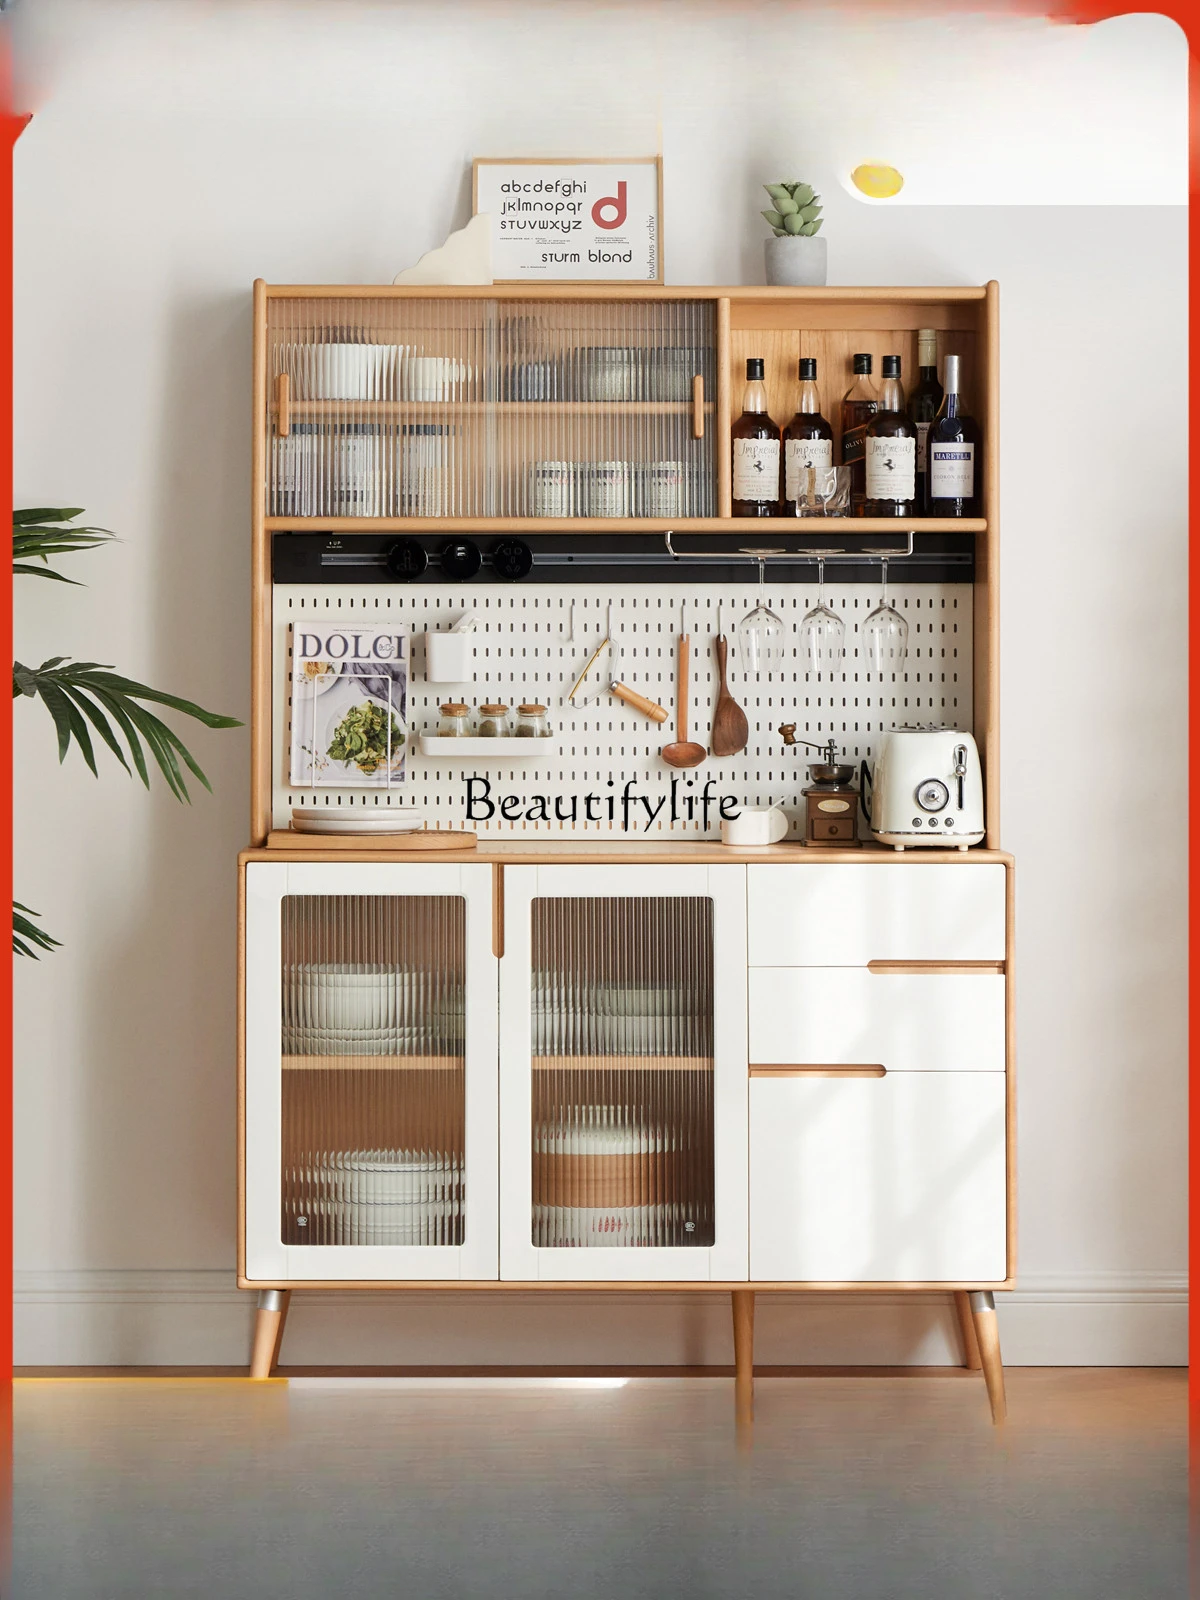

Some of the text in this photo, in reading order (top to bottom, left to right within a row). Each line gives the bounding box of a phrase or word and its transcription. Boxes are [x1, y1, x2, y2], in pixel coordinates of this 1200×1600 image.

[500, 180, 587, 197] abcdefghi
[500, 198, 583, 215] jklmnopqr
[591, 181, 627, 230] d
[541, 249, 632, 263] sturm blond
[299, 634, 405, 659] DOLCI
